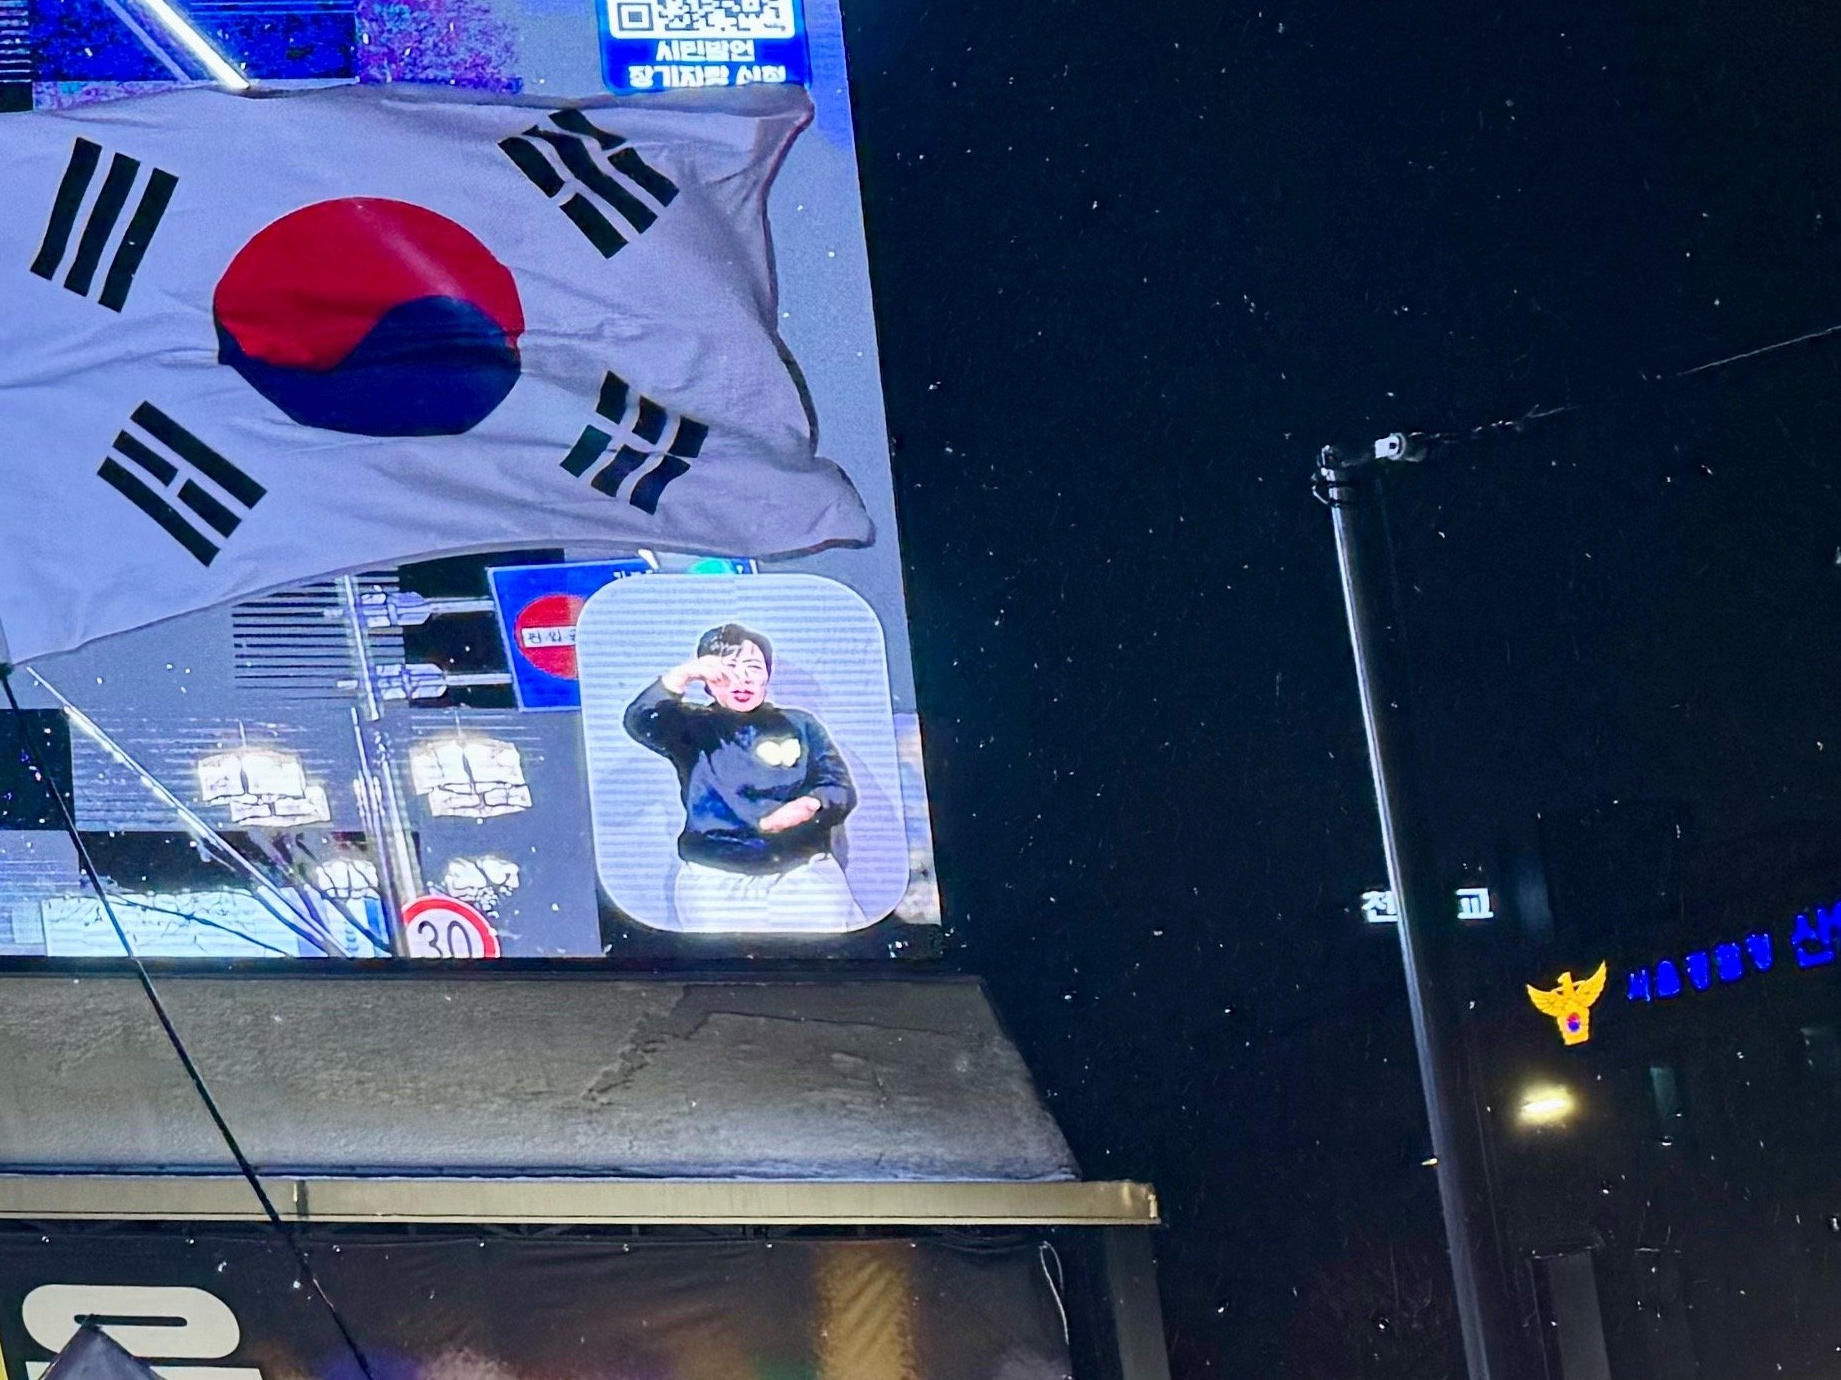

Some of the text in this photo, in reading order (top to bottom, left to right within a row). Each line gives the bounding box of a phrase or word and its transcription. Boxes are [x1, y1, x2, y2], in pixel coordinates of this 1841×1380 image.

[656, 39, 756, 62] 시민발언
[628, 65, 730, 89] 장기자랑
[1361, 886, 1495, 924] 천교
[417, 920, 473, 957] 30
